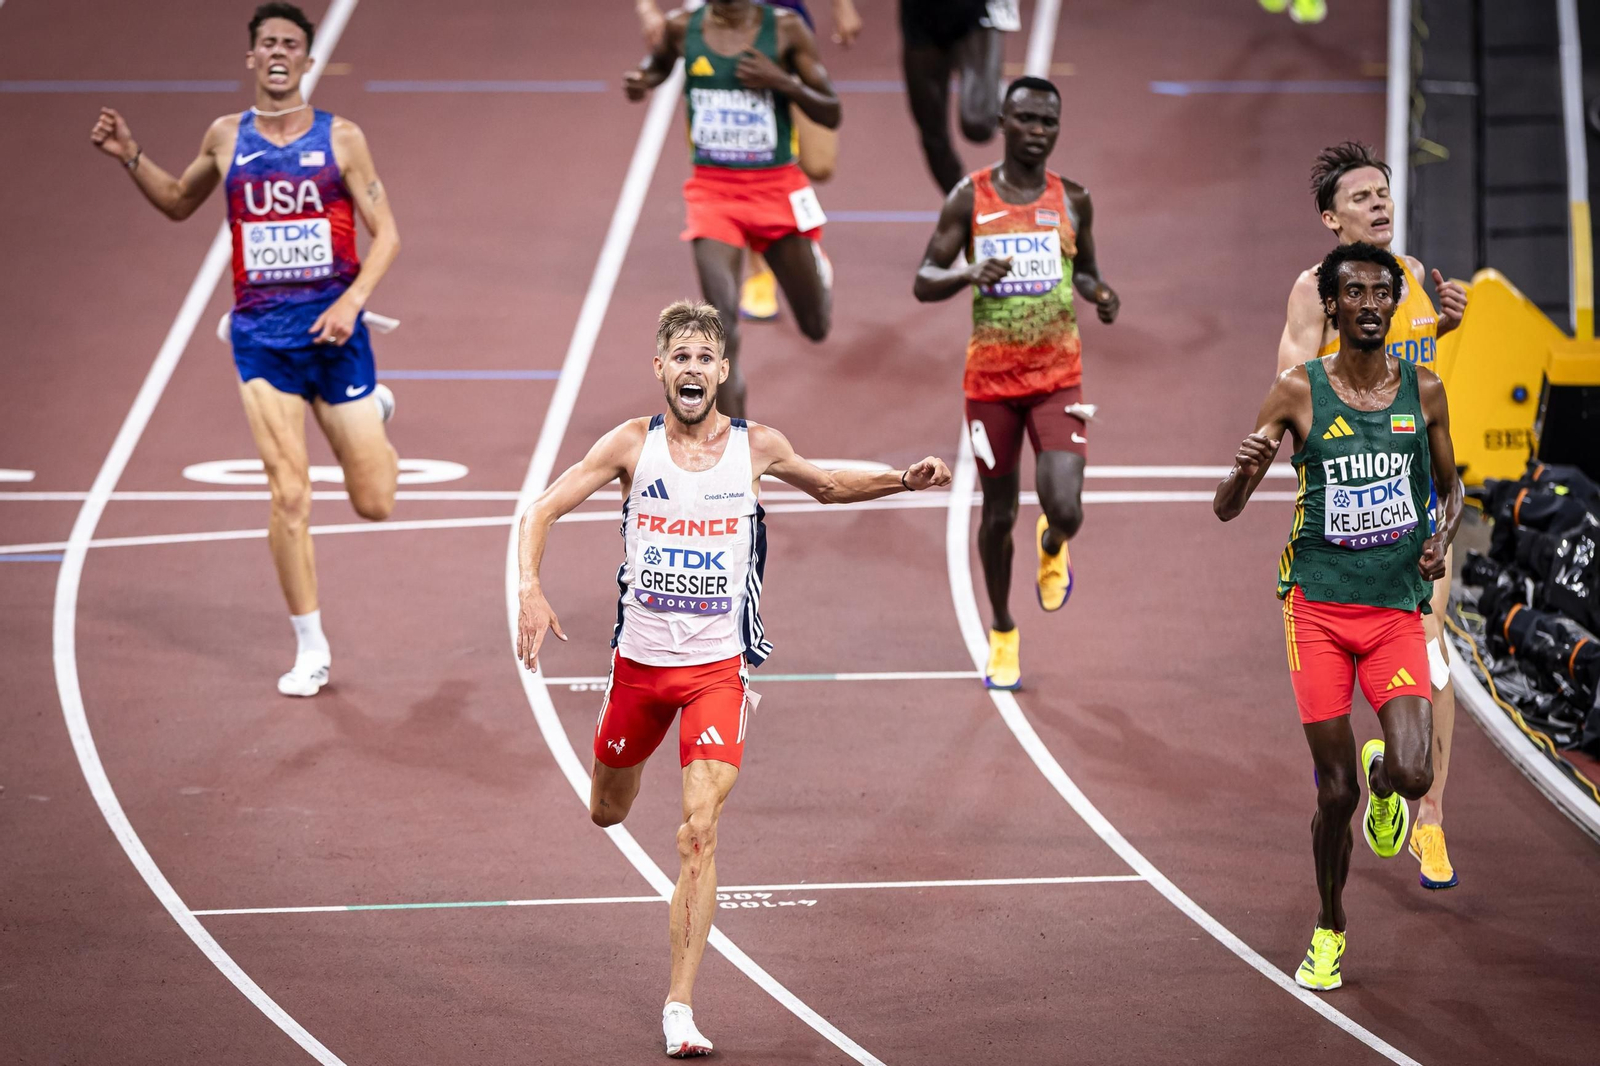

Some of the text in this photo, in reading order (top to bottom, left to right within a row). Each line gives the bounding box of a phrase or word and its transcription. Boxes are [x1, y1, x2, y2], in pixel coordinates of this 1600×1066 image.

[718, 108, 767, 126] TDK
[244, 180, 324, 215] USA
[265, 223, 321, 242] TDK
[250, 245, 326, 265] YOUNG
[996, 237, 1051, 254] TDK
[1386, 336, 1436, 364] EDEN
[1349, 478, 1405, 508] TDK
[637, 512, 739, 537] FRANCE
[1330, 501, 1413, 533] KEJELCHA
[661, 547, 726, 571] TDK
[640, 569, 728, 596] GRESSIER
